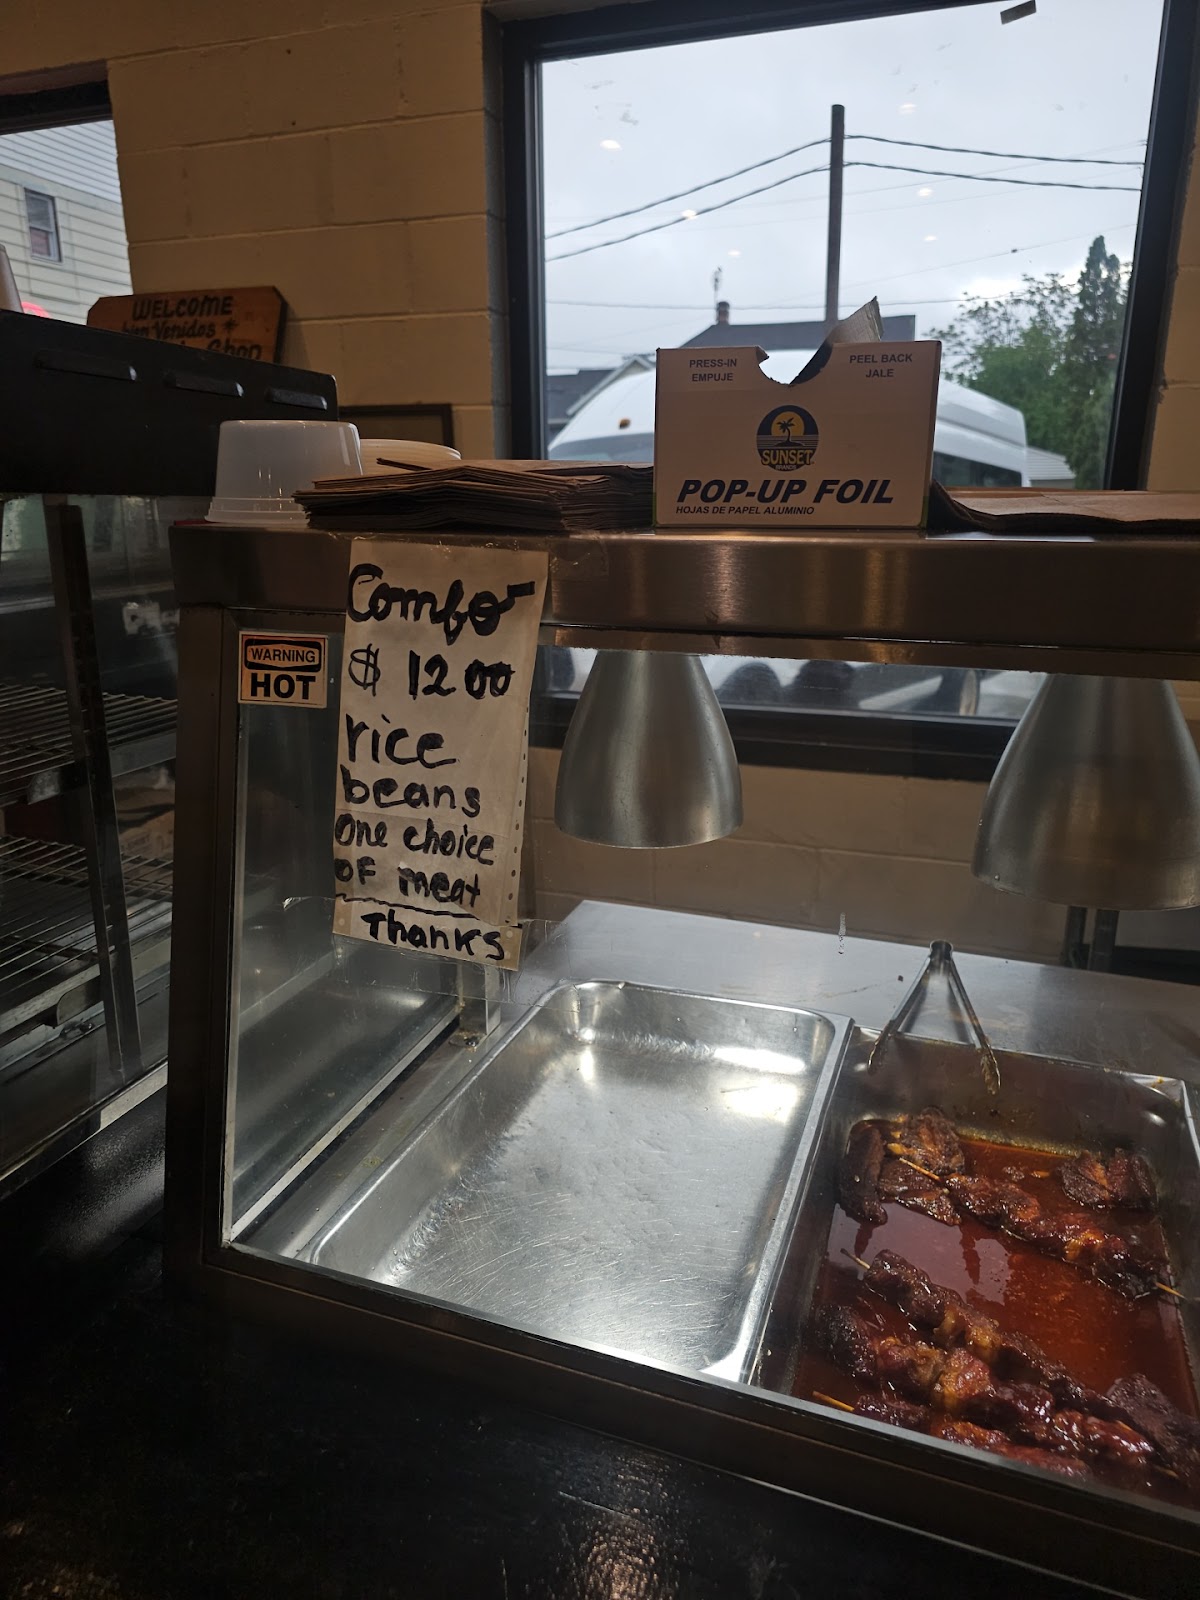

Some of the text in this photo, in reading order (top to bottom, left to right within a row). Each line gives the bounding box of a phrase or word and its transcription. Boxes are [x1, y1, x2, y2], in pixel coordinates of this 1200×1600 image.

[132, 295, 234, 320] WELCOME
[152, 319, 216, 339] Venidos
[689, 358, 737, 368] PRESS-IN
[849, 353, 913, 364] PEEL BACK
[691, 372, 734, 382] EMPUJE
[865, 369, 894, 378] JALE
[761, 449, 813, 465] SUNSET
[677, 479, 894, 504] POP-UP FOIL
[676, 506, 815, 515] HOJAS DE PAPEL ALUMINIO
[251, 648, 316, 663] WARNING
[348, 644, 381, 696] $
[250, 673, 316, 700] HOT
[345, 714, 457, 769] rice
[340, 764, 481, 818] beans
[403, 818, 495, 866] choice
[397, 866, 481, 908] meat
